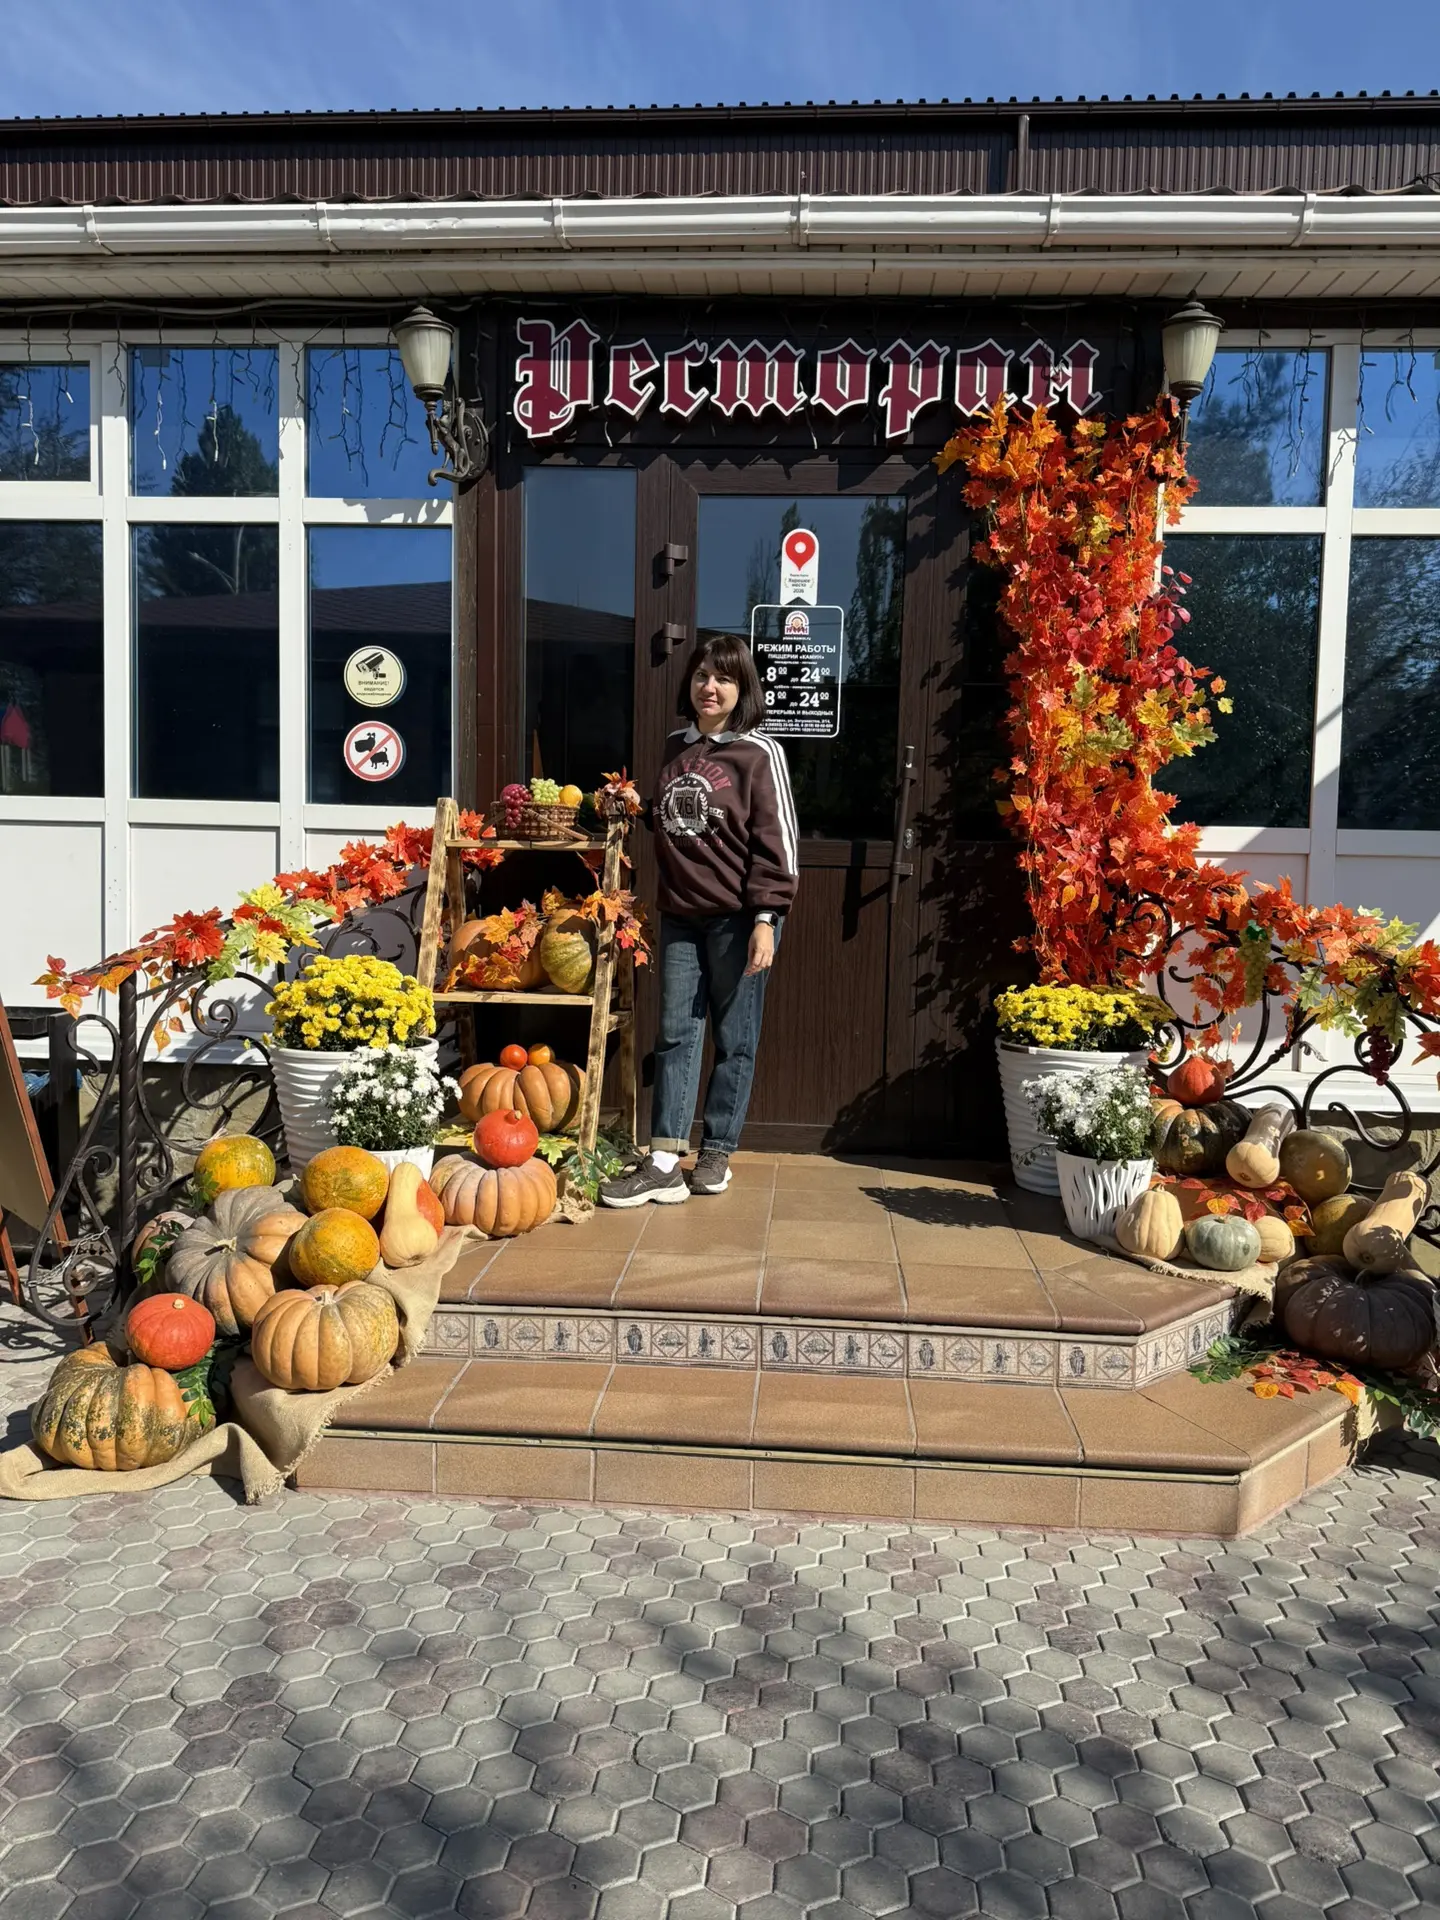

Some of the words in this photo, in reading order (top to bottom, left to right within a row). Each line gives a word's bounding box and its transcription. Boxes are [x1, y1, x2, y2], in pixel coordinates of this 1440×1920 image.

[513, 318, 1103, 438] Ресторан
[757, 643, 793, 653] РЕЖИМ
[795, 644, 836, 653] РАБОТЫ
